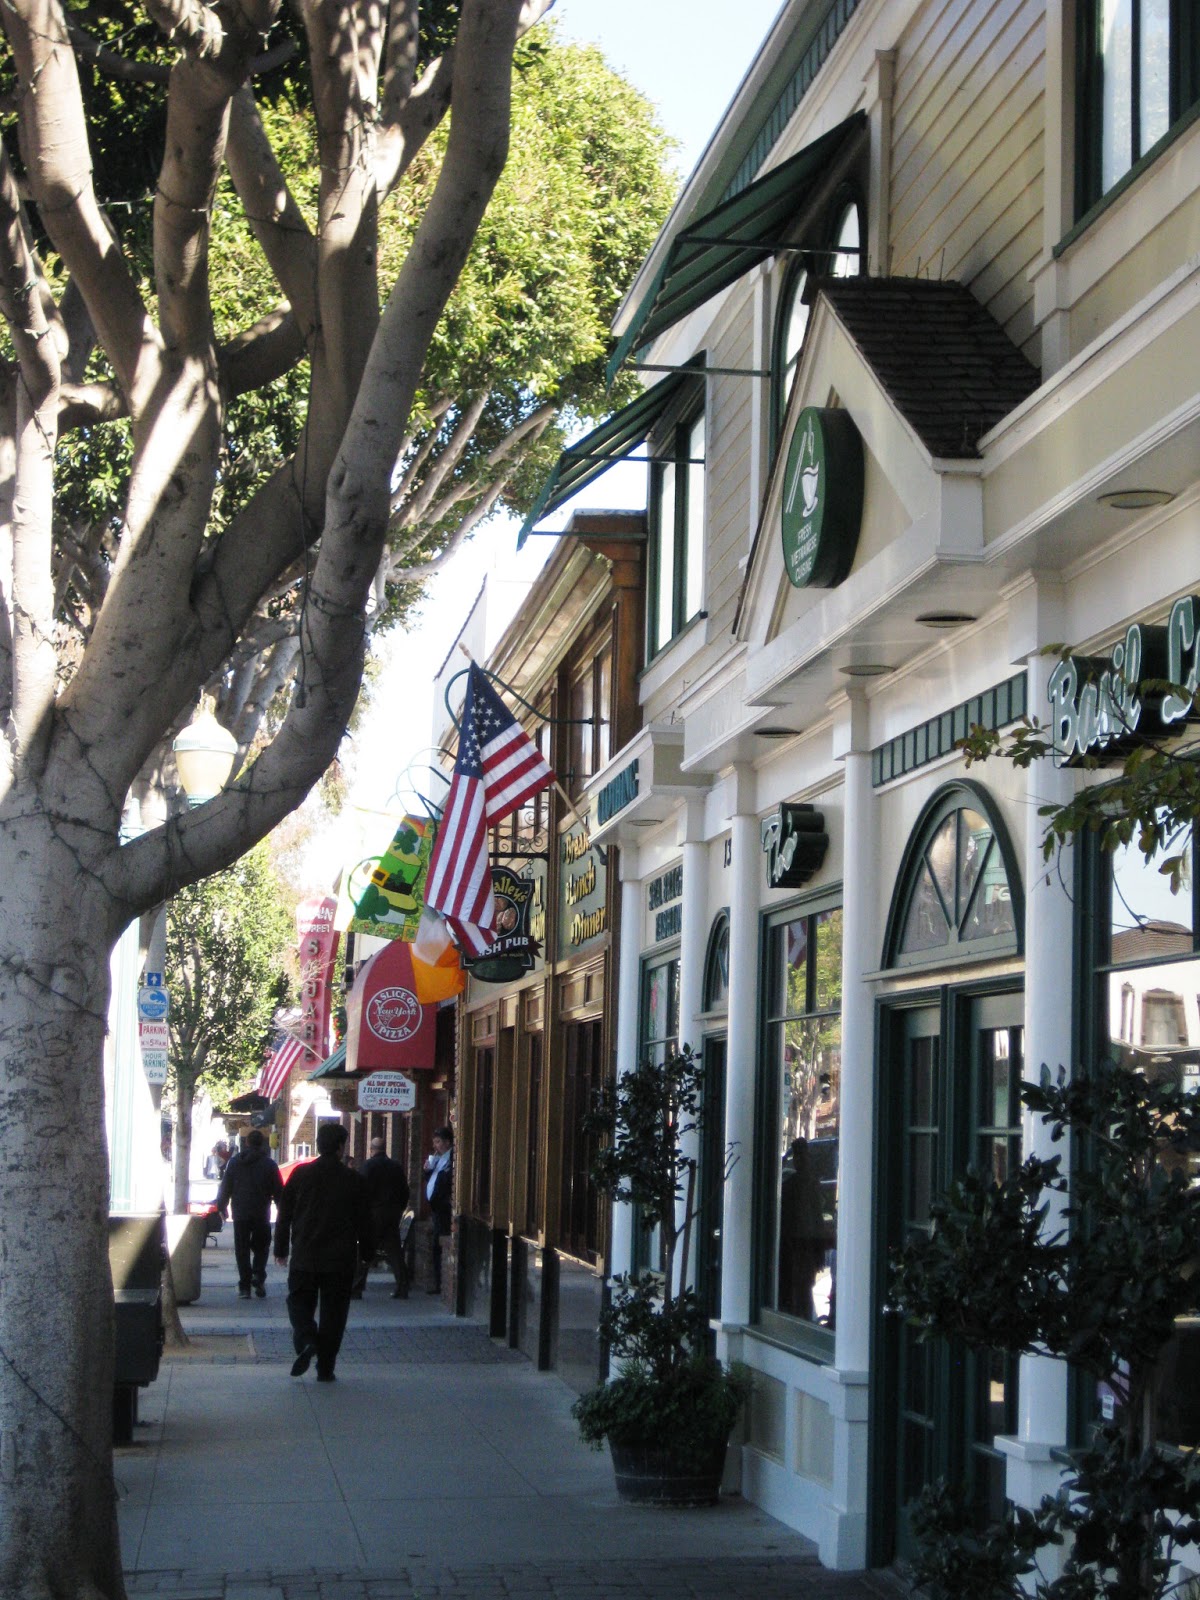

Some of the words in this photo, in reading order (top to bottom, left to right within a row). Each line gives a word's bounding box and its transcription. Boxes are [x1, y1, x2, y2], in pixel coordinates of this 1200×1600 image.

[1048, 624, 1142, 769] Basil
[565, 856, 596, 906] Lunch
[570, 908, 605, 947] Dinner
[505, 936, 529, 950] PUB
[374, 998, 382, 1006] A
[380, 990, 407, 1001] SLICE
[406, 997, 418, 1008] OF
[376, 1005, 395, 1017] New
[143, 1025, 167, 1036] PARKING
[378, 1026, 412, 1039] PIZZA
[378, 1098, 400, 1107] $5.99
